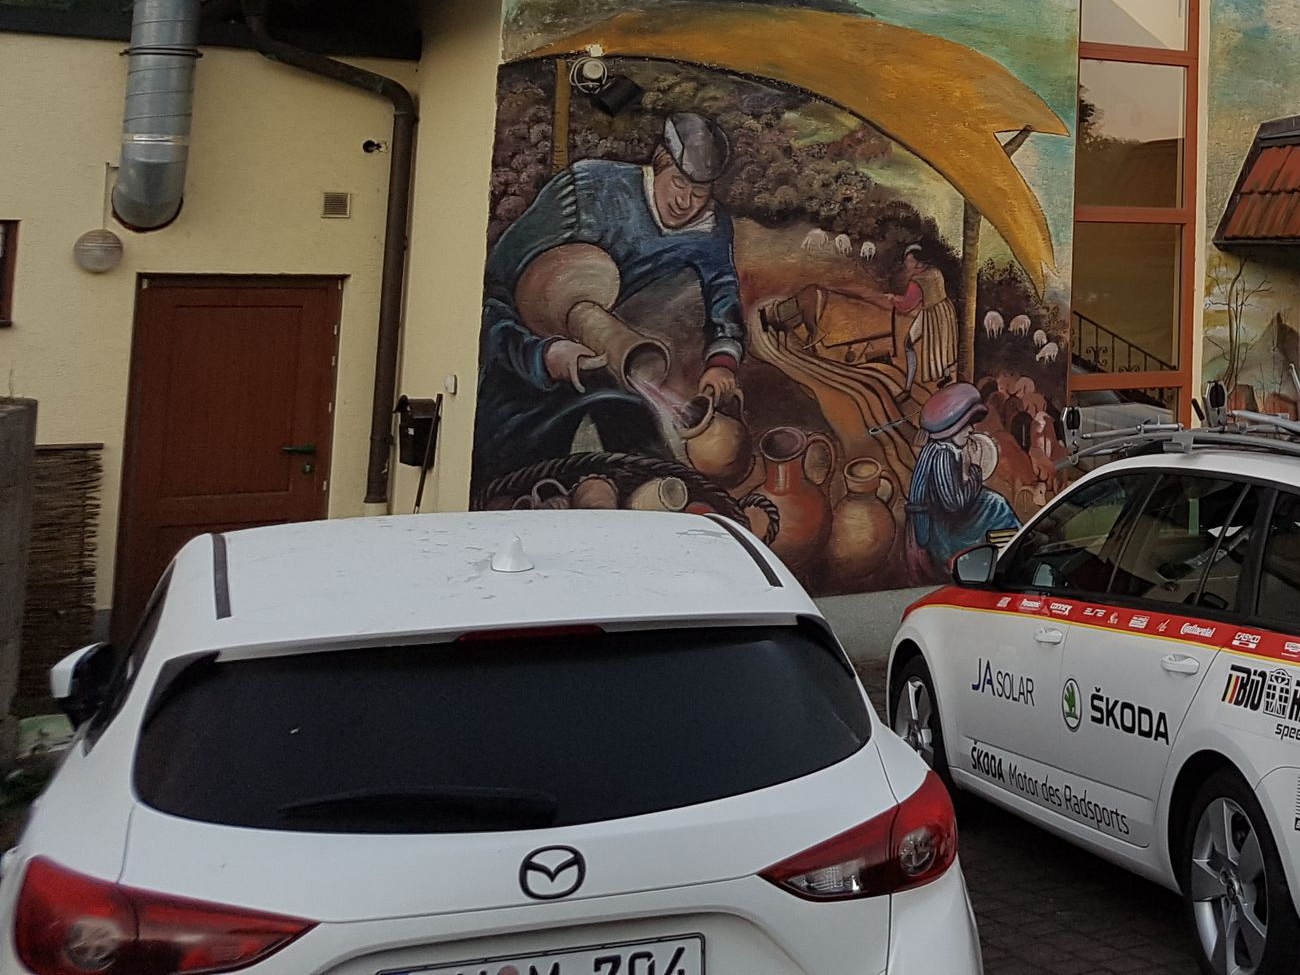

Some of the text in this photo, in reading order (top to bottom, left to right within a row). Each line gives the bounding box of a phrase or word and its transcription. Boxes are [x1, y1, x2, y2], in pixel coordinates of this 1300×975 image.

[971, 658, 1035, 707] JA SOLAR
[1090, 686, 1170, 745] ŠKODA
[971, 739, 1130, 836] ŠKODA Motor des Radsports
